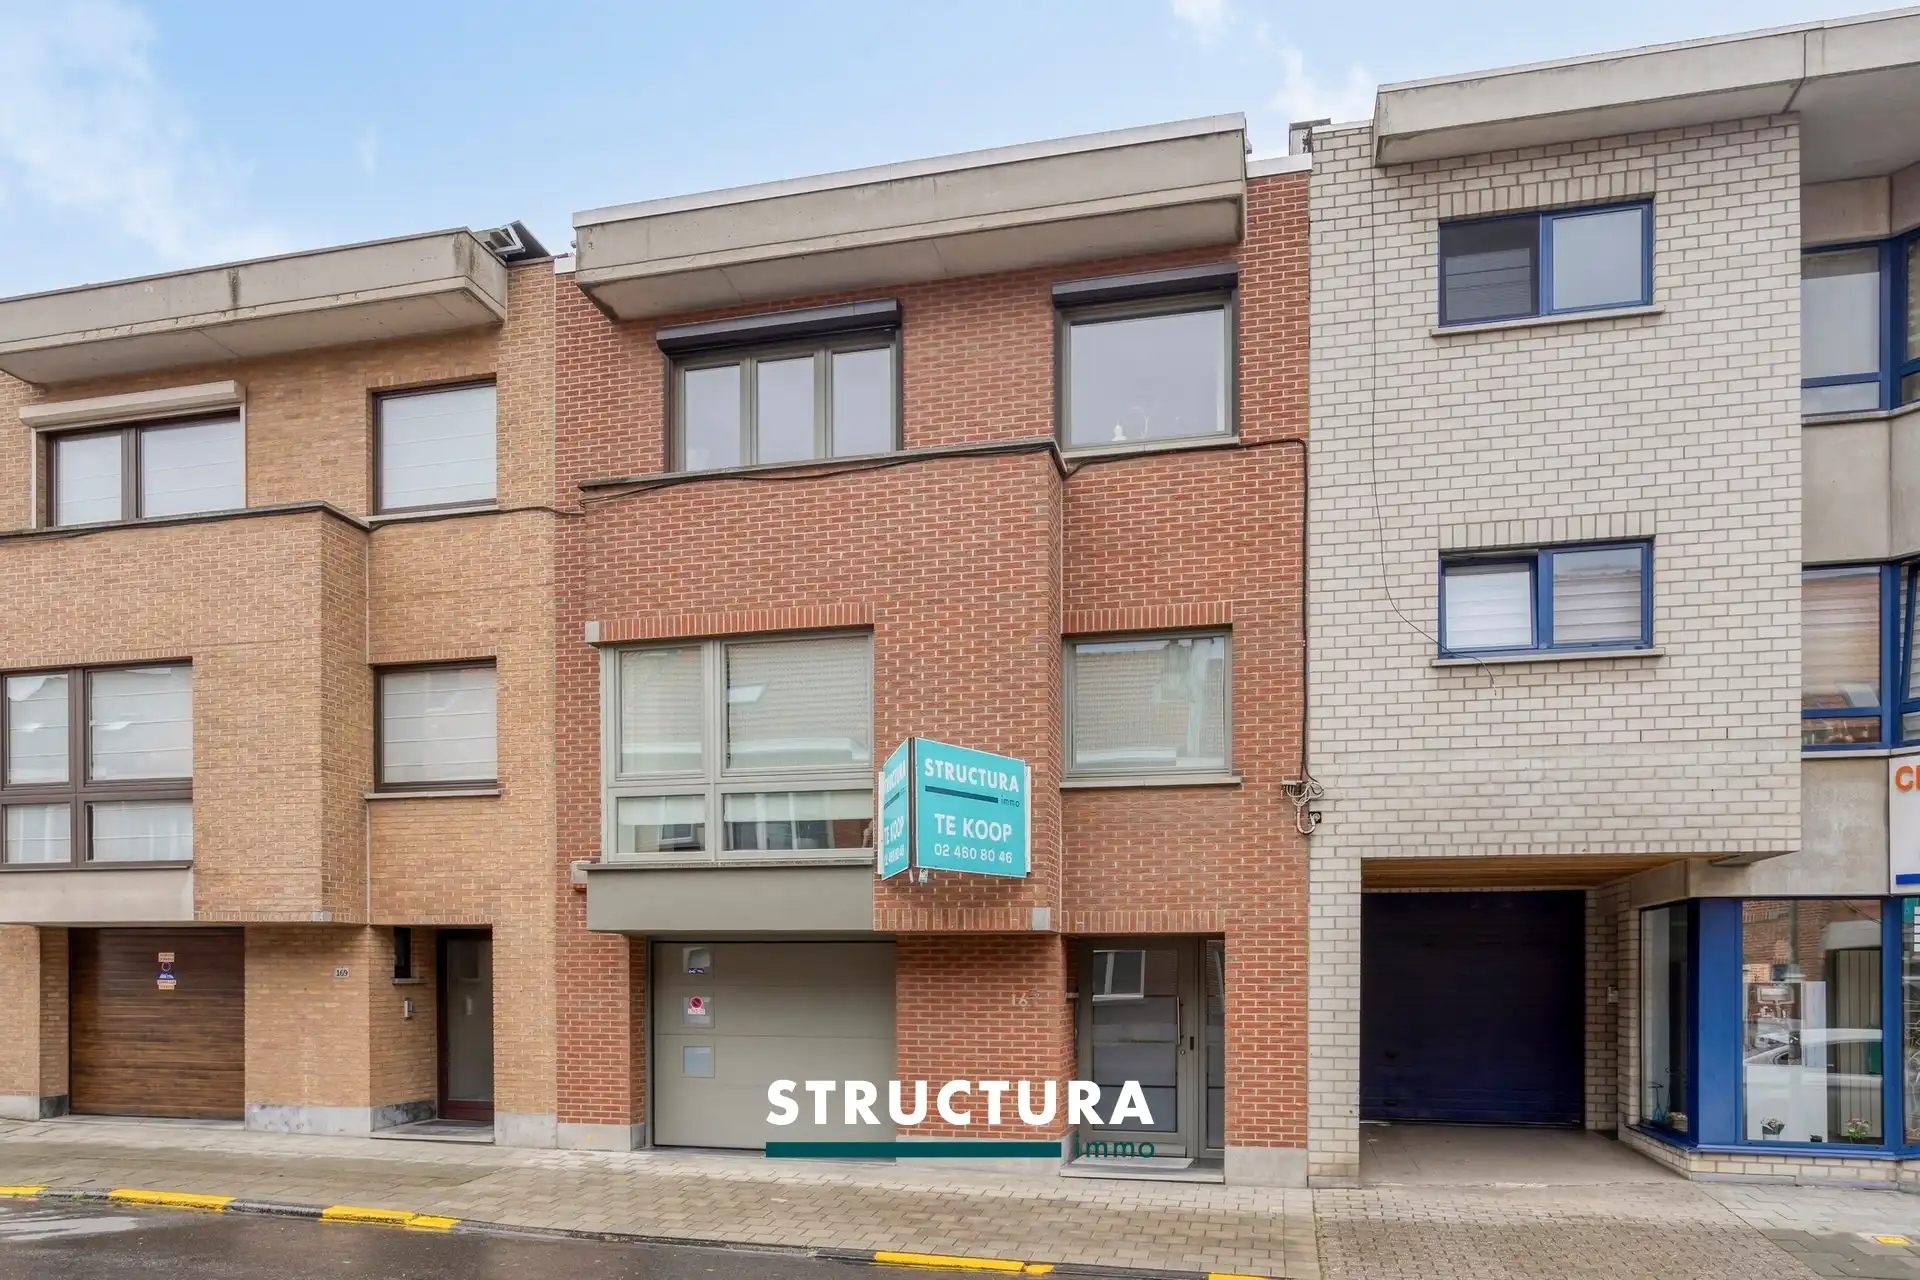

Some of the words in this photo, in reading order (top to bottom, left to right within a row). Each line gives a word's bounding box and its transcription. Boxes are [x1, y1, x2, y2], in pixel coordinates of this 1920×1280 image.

[925, 758, 1020, 793] STRUCTURA
[1000, 794, 1020, 808] immo
[934, 813, 956, 836] TE
[963, 817, 1012, 843] KOOP
[934, 843, 950, 857] 02
[953, 845, 977, 860] 460
[980, 848, 995, 862] 80
[998, 850, 1013, 864] 46
[336, 969, 348, 977] 169
